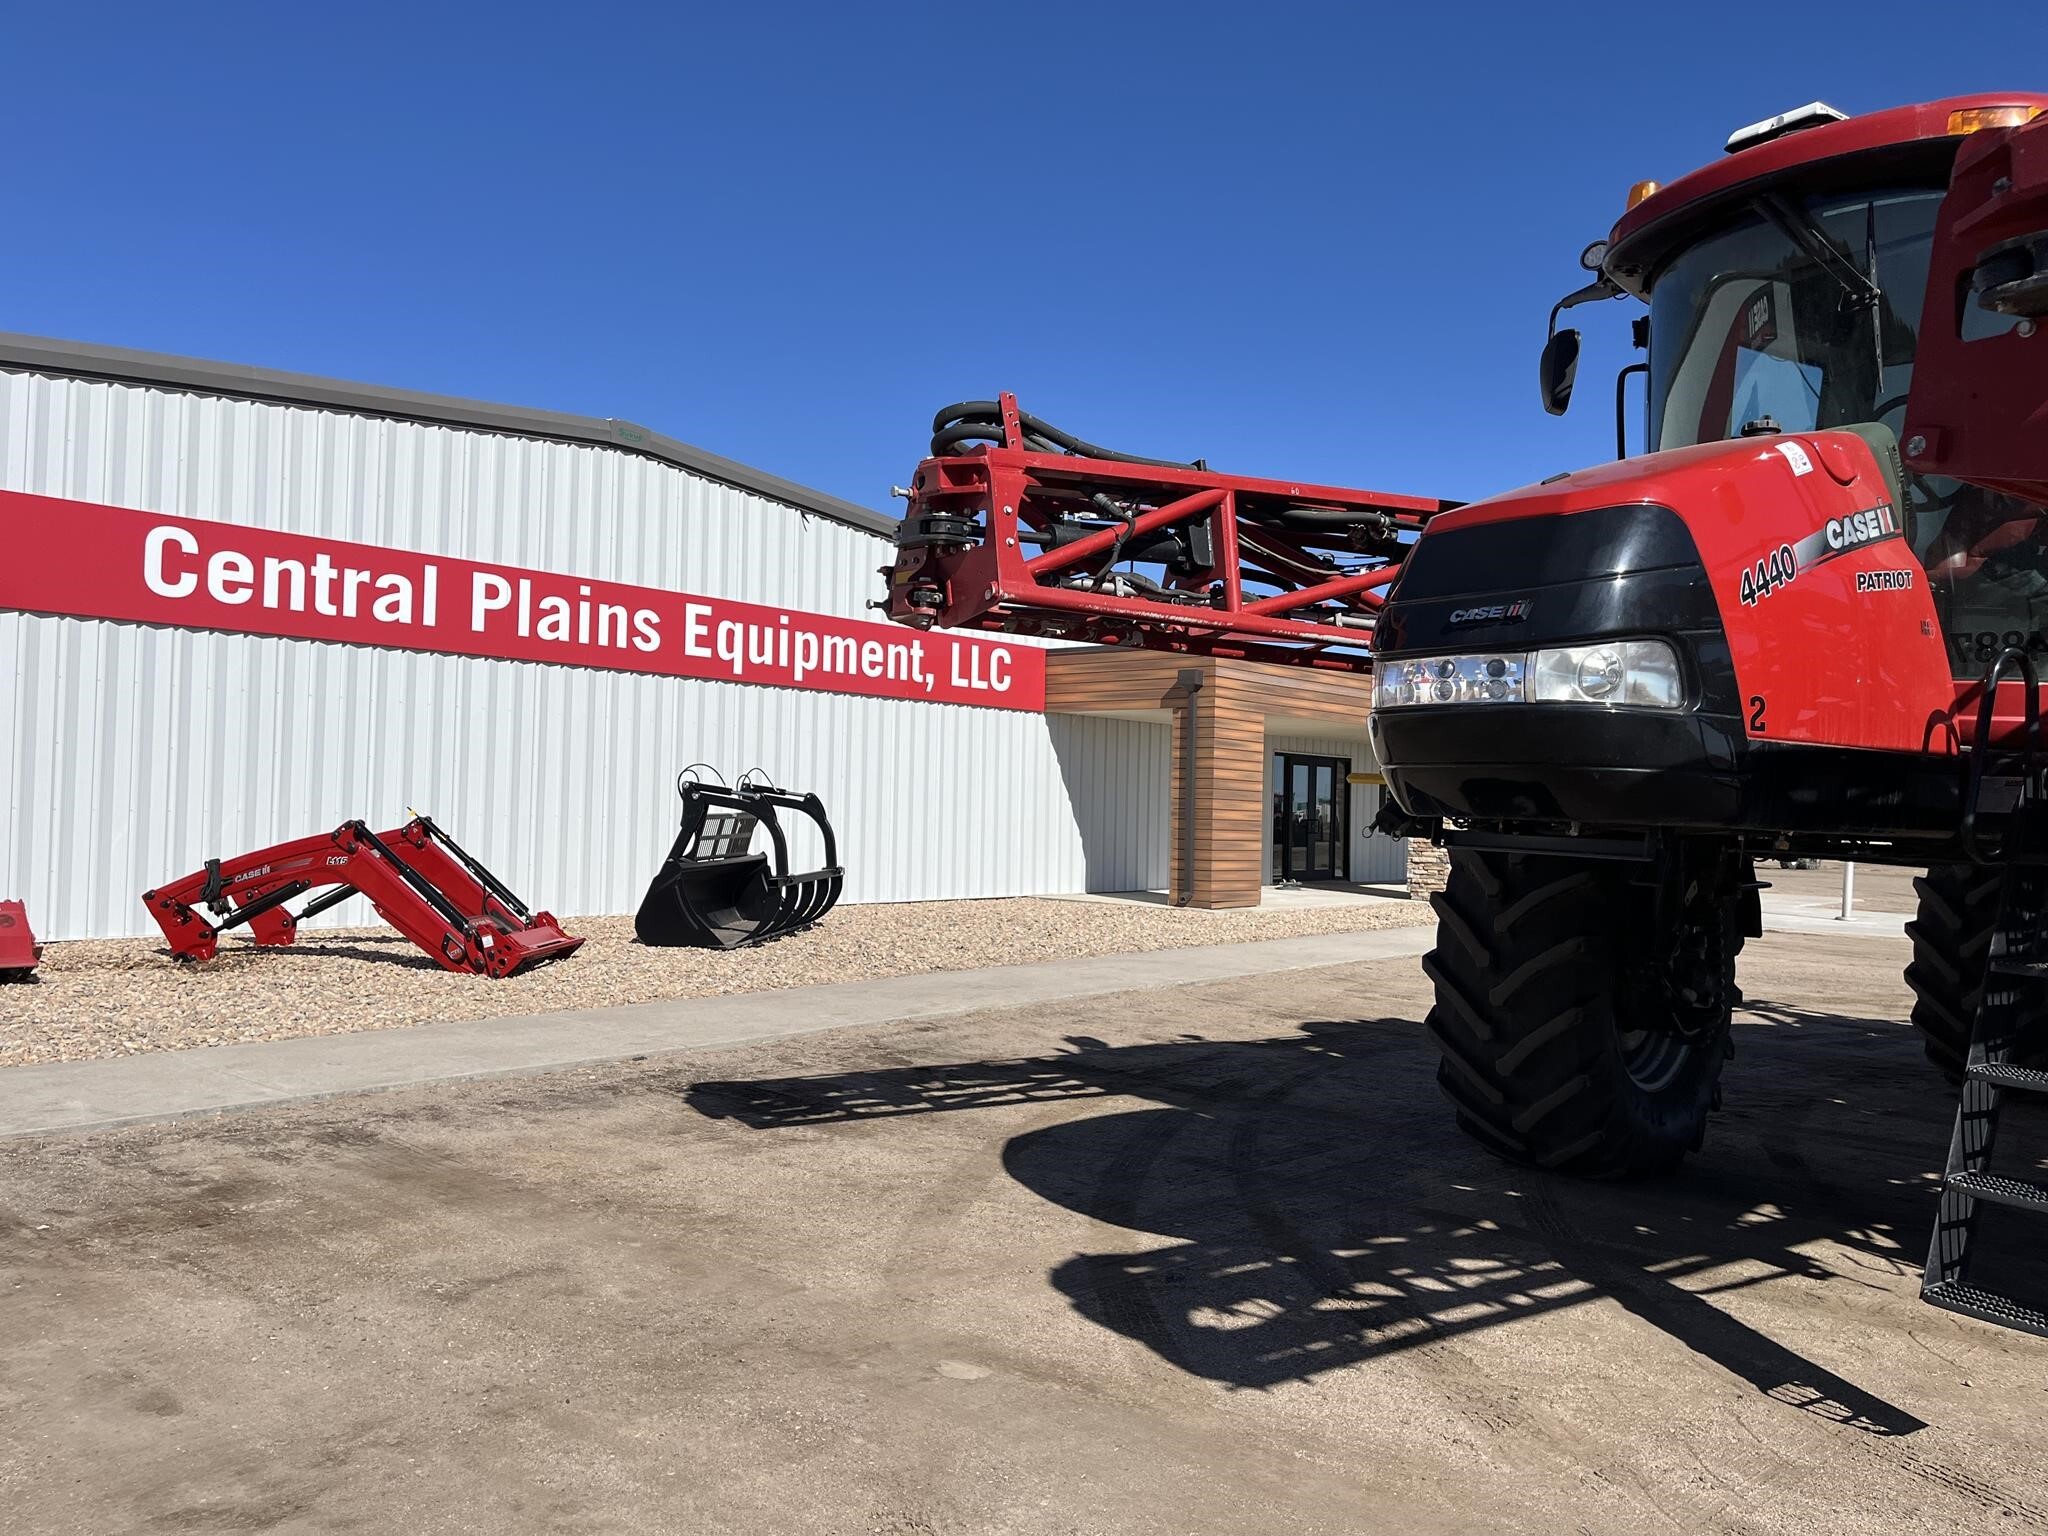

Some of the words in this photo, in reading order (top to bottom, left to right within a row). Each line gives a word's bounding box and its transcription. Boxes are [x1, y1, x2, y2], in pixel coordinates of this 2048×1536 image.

[1826, 509, 1881, 550] CASE
[1740, 544, 1797, 607] 4440
[1856, 570, 1912, 592] PATRIOT
[143, 525, 438, 627] Central
[470, 571, 661, 652] Plains
[684, 602, 935, 692] Equipment,
[950, 642, 1012, 692] LLC
[1449, 606, 1505, 623] CASE
[1750, 696, 1766, 732] 2
[234, 868, 262, 883] CASE
